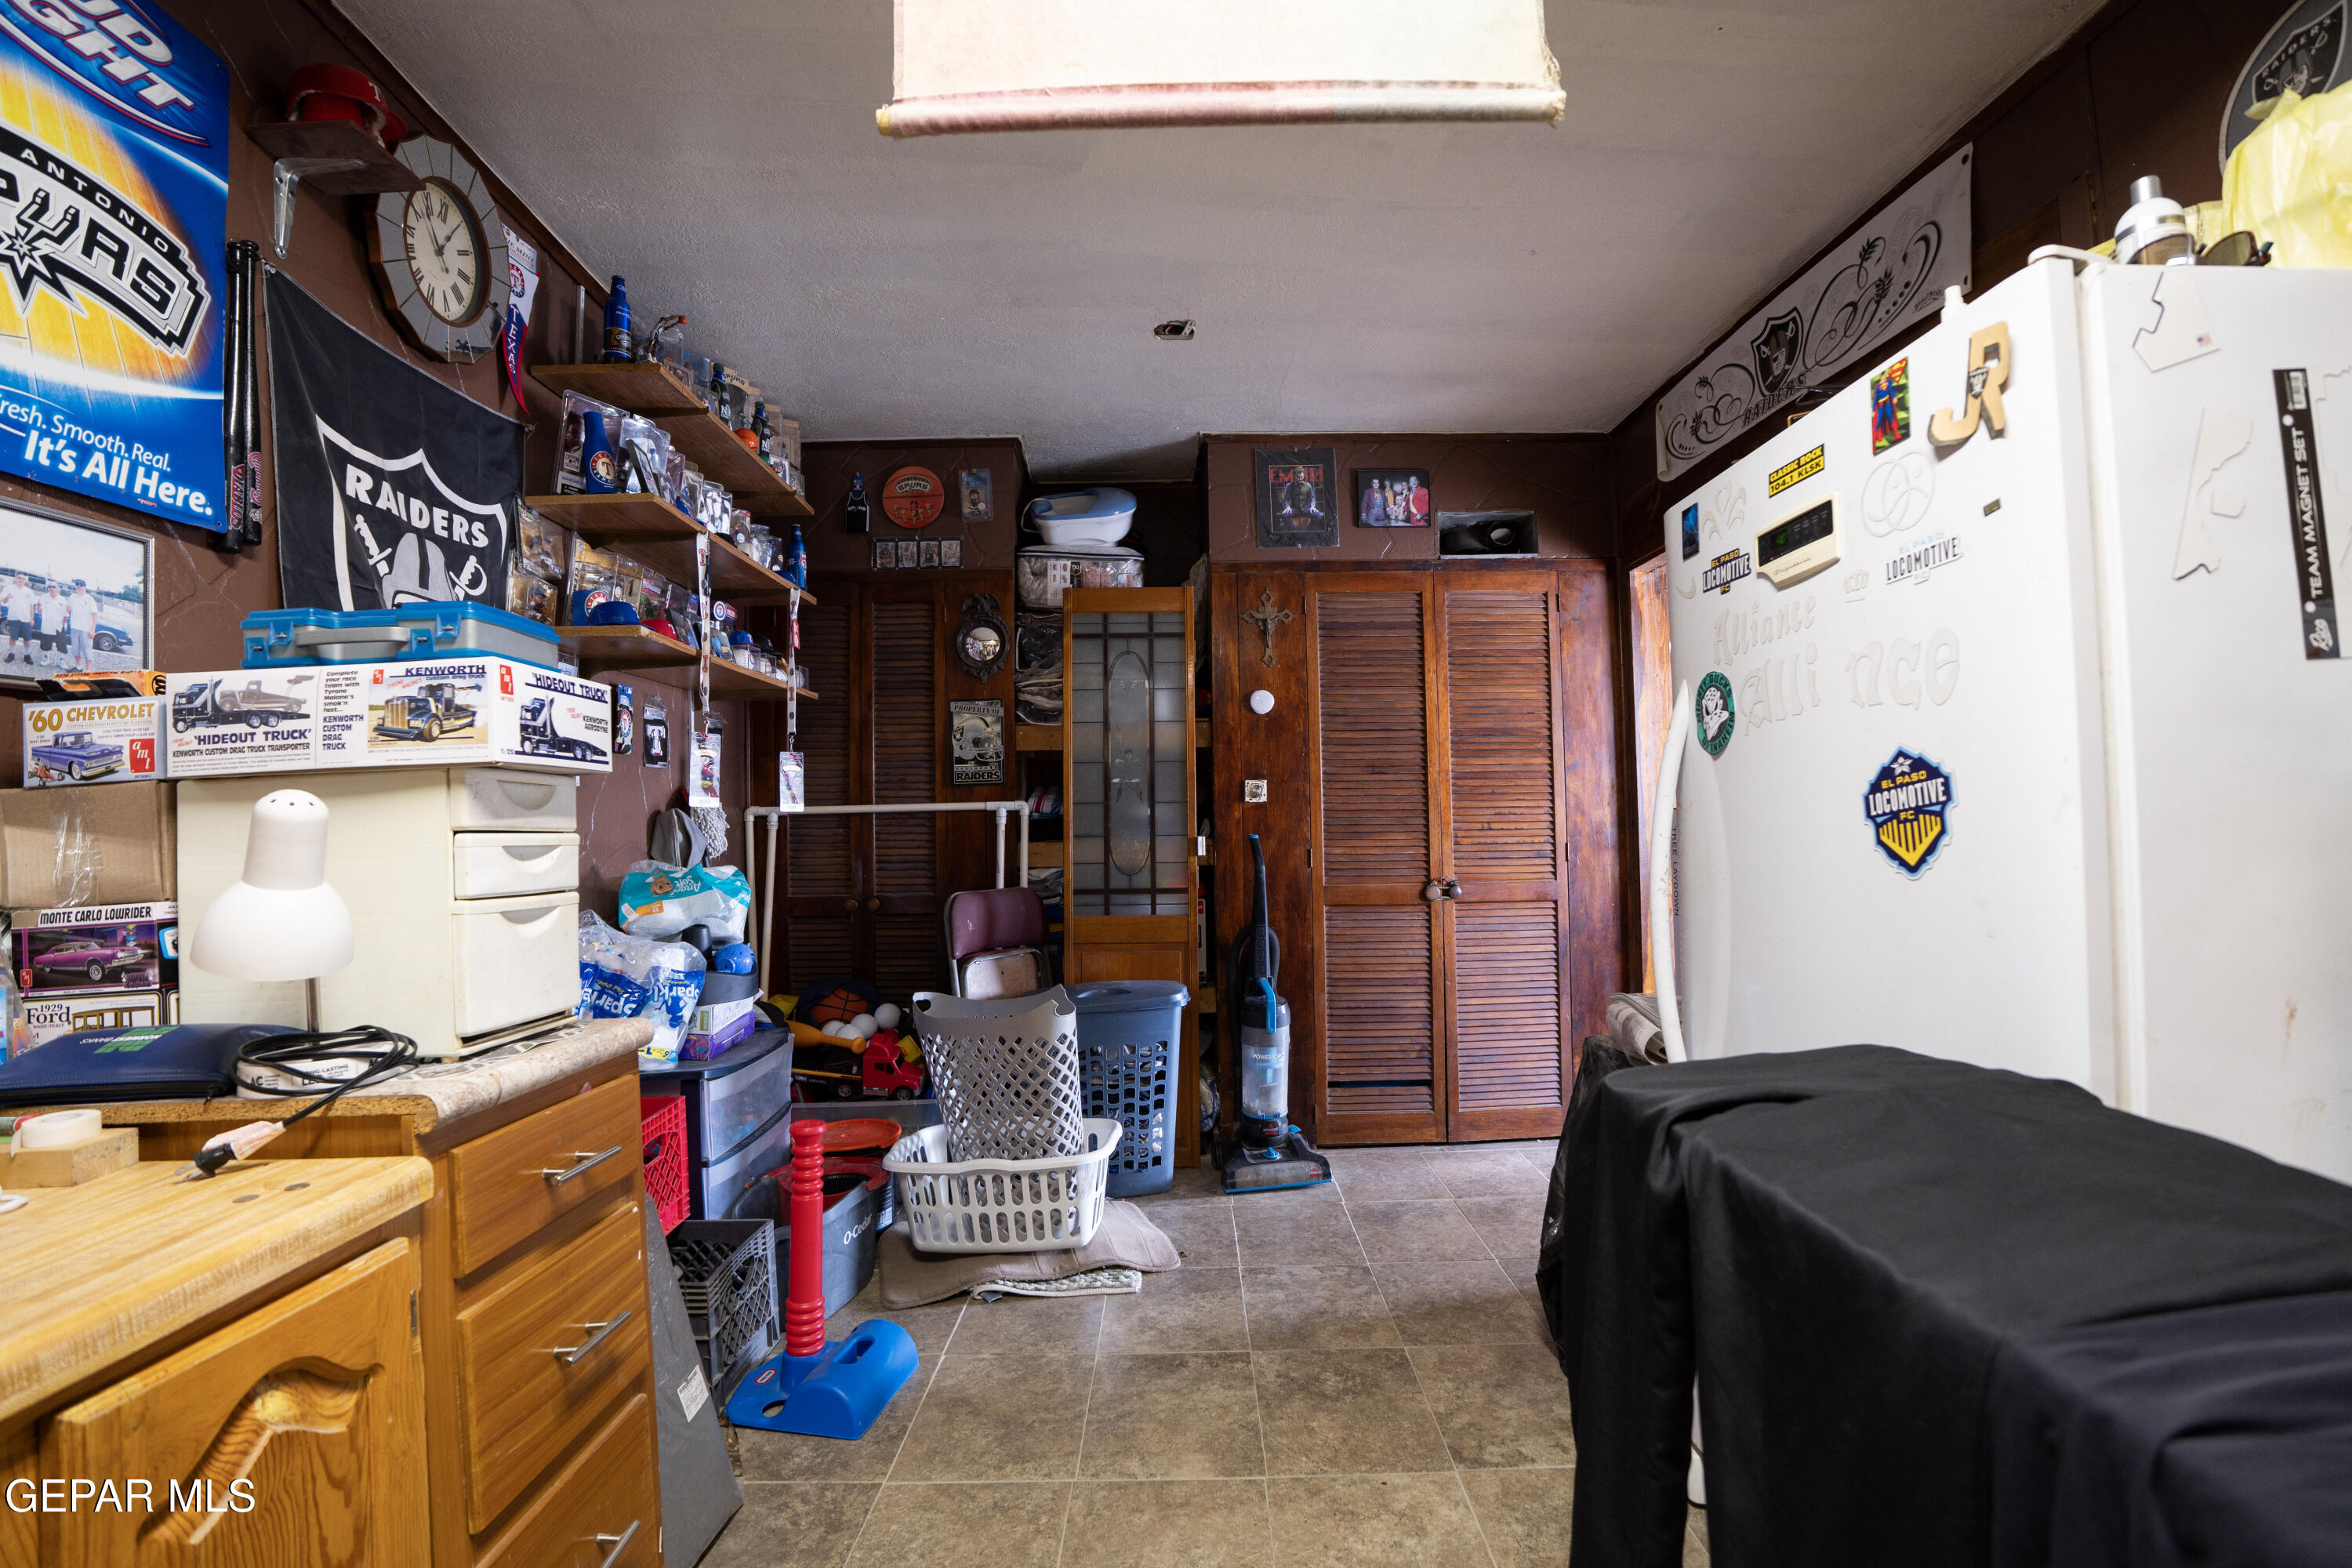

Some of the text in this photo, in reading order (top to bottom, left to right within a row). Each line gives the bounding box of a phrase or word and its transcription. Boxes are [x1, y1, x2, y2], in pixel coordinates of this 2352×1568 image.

[20, 148, 169, 252] ANTONIO
[507, 304, 520, 375] TEXAS
[51, 415, 129, 458] Smooth.
[132, 443, 171, 472] Real.
[24, 430, 78, 473] It's
[82, 451, 130, 490] All
[133, 467, 213, 516] Here.
[1769, 445, 1823, 483] CLASSIC ROCK
[1770, 459, 1822, 494] 104.1 KLSK
[898, 482, 929, 494] SPURS
[346, 463, 489, 548] RAIDERS
[2292, 427, 2324, 598] TEAM MAGNET SET
[1711, 550, 1740, 568] EL PASO
[1886, 537, 1958, 581] LOCOMOTIVE
[1703, 554, 1751, 592] LOCOMOTIVE
[1720, 583, 1730, 593] FC
[1714, 596, 1817, 666] Alliance
[405, 664, 487, 677] KENWORTH
[1709, 674, 1733, 698] DUCKS
[28, 703, 155, 733] '60 CHEVROLET
[322, 714, 365, 723] KENWORTH
[322, 724, 353, 732] CUSTOM
[583, 714, 609, 726] KENWORTH
[584, 723, 609, 734] AERODYNE
[1710, 711, 1735, 753] ANAHEIM
[172, 742, 310, 758] KENWORTH CUSTOM DRAG TRUCK TRANSPORTER
[956, 771, 1000, 781] RAIDERS
[1881, 770, 1927, 789] EL PASO
[1868, 777, 1947, 816] LOCOMOTIVE
[1900, 810, 1915, 821] FC
[670, 875, 702, 897] Angel Soft
[40, 911, 73, 925] MONTE
[74, 909, 103, 923] CARLO
[104, 906, 152, 921] LOWRIDER
[26, 1006, 71, 1025] Ford
[40, 1004, 63, 1014] 1929
[250, 1076, 263, 1087] AC
[844, 1213, 873, 1245] O-Cedar
